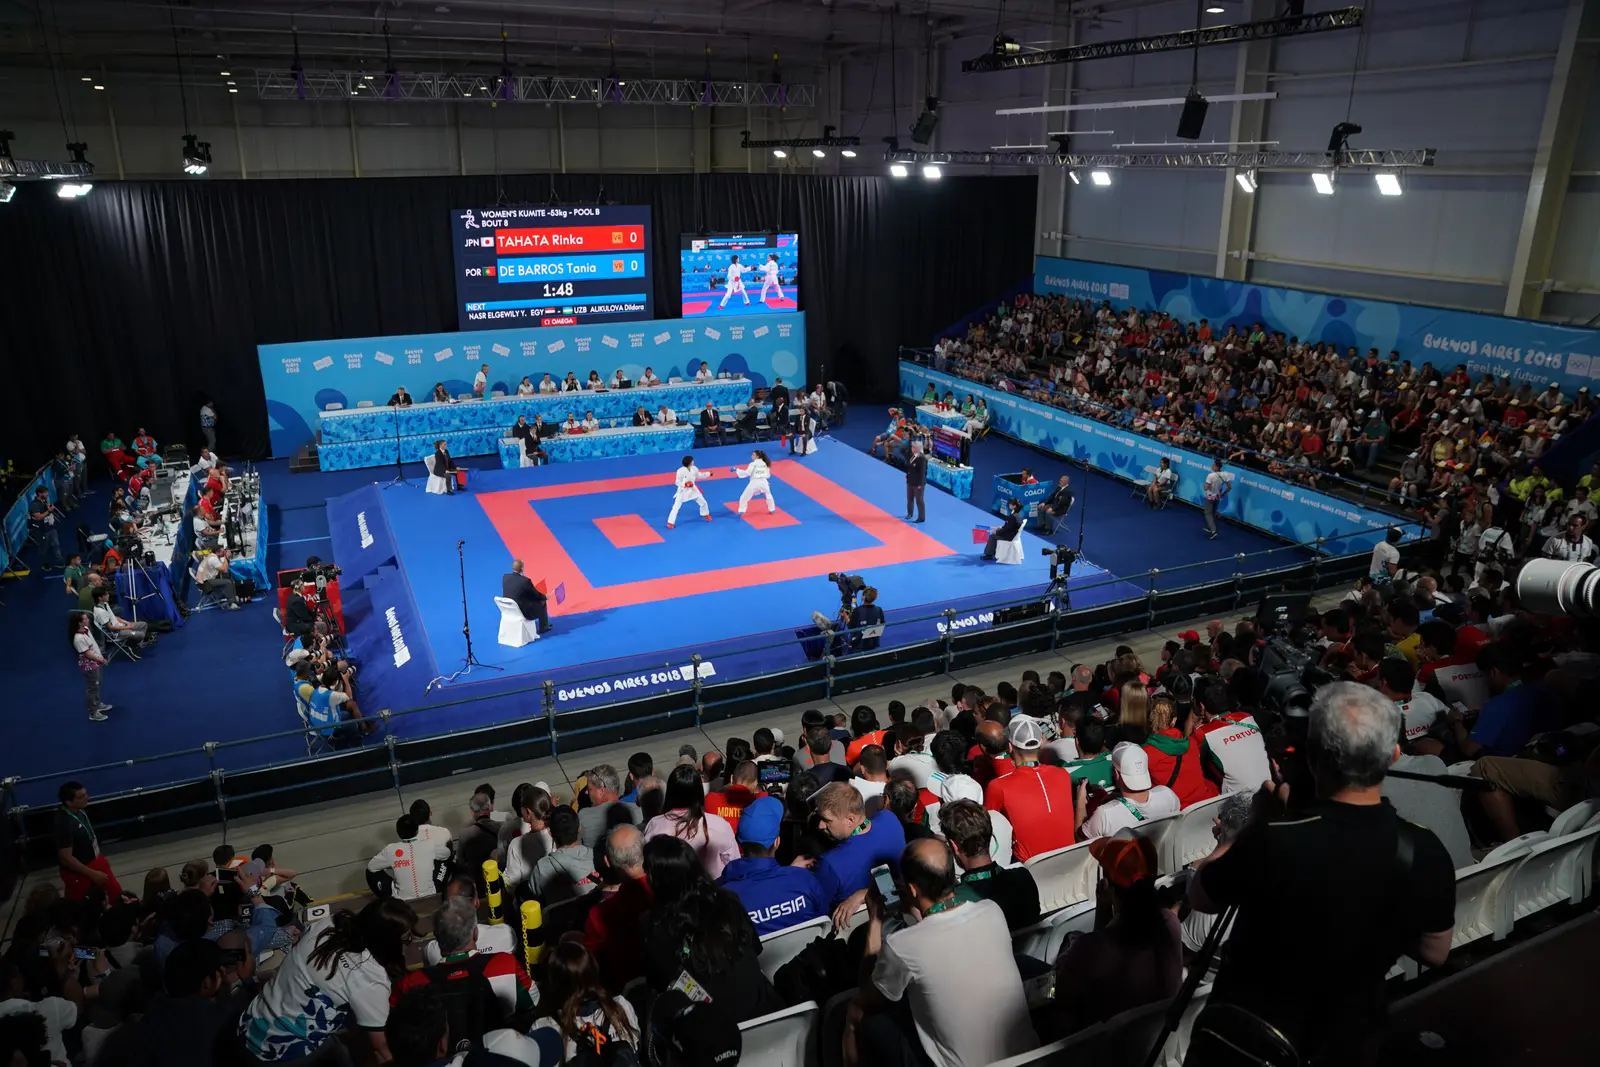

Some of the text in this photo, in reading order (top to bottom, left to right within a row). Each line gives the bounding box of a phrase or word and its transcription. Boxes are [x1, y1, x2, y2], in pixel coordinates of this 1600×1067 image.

[480, 210, 517, 218] WOMEN'S
[518, 209, 546, 217] KUMITE
[574, 208, 594, 216] POOL
[482, 220, 502, 228] BOUT
[465, 238, 480, 247] JPN
[498, 235, 550, 247] TAHATA
[552, 234, 583, 245] Rinka
[630, 232, 637, 243] 0
[465, 268, 482, 277] POR
[500, 265, 514, 277] DE
[518, 264, 564, 276] BARROS
[567, 262, 596, 274] Tania
[631, 260, 638, 271] 0
[543, 283, 574, 297] 1:48
[468, 312, 487, 320] NASR
[530, 308, 544, 316] EGY
[574, 306, 587, 314] UZB
[1423, 333, 1562, 369] BUENOS AIRES 2018
[1466, 360, 1548, 384] Feel the future
[998, 485, 1012, 496] COACH
[1024, 488, 1045, 497] COACH
[978, 612, 993, 622] AIR
[1452, 672, 1482, 681] PORTUG
[558, 670, 680, 701] BUENOS AIRES 2018
[1223, 728, 1258, 745] PORTUG
[717, 806, 742, 818] MONTE
[393, 860, 410, 868] JAPAN
[748, 894, 806, 924] RUSSIA
